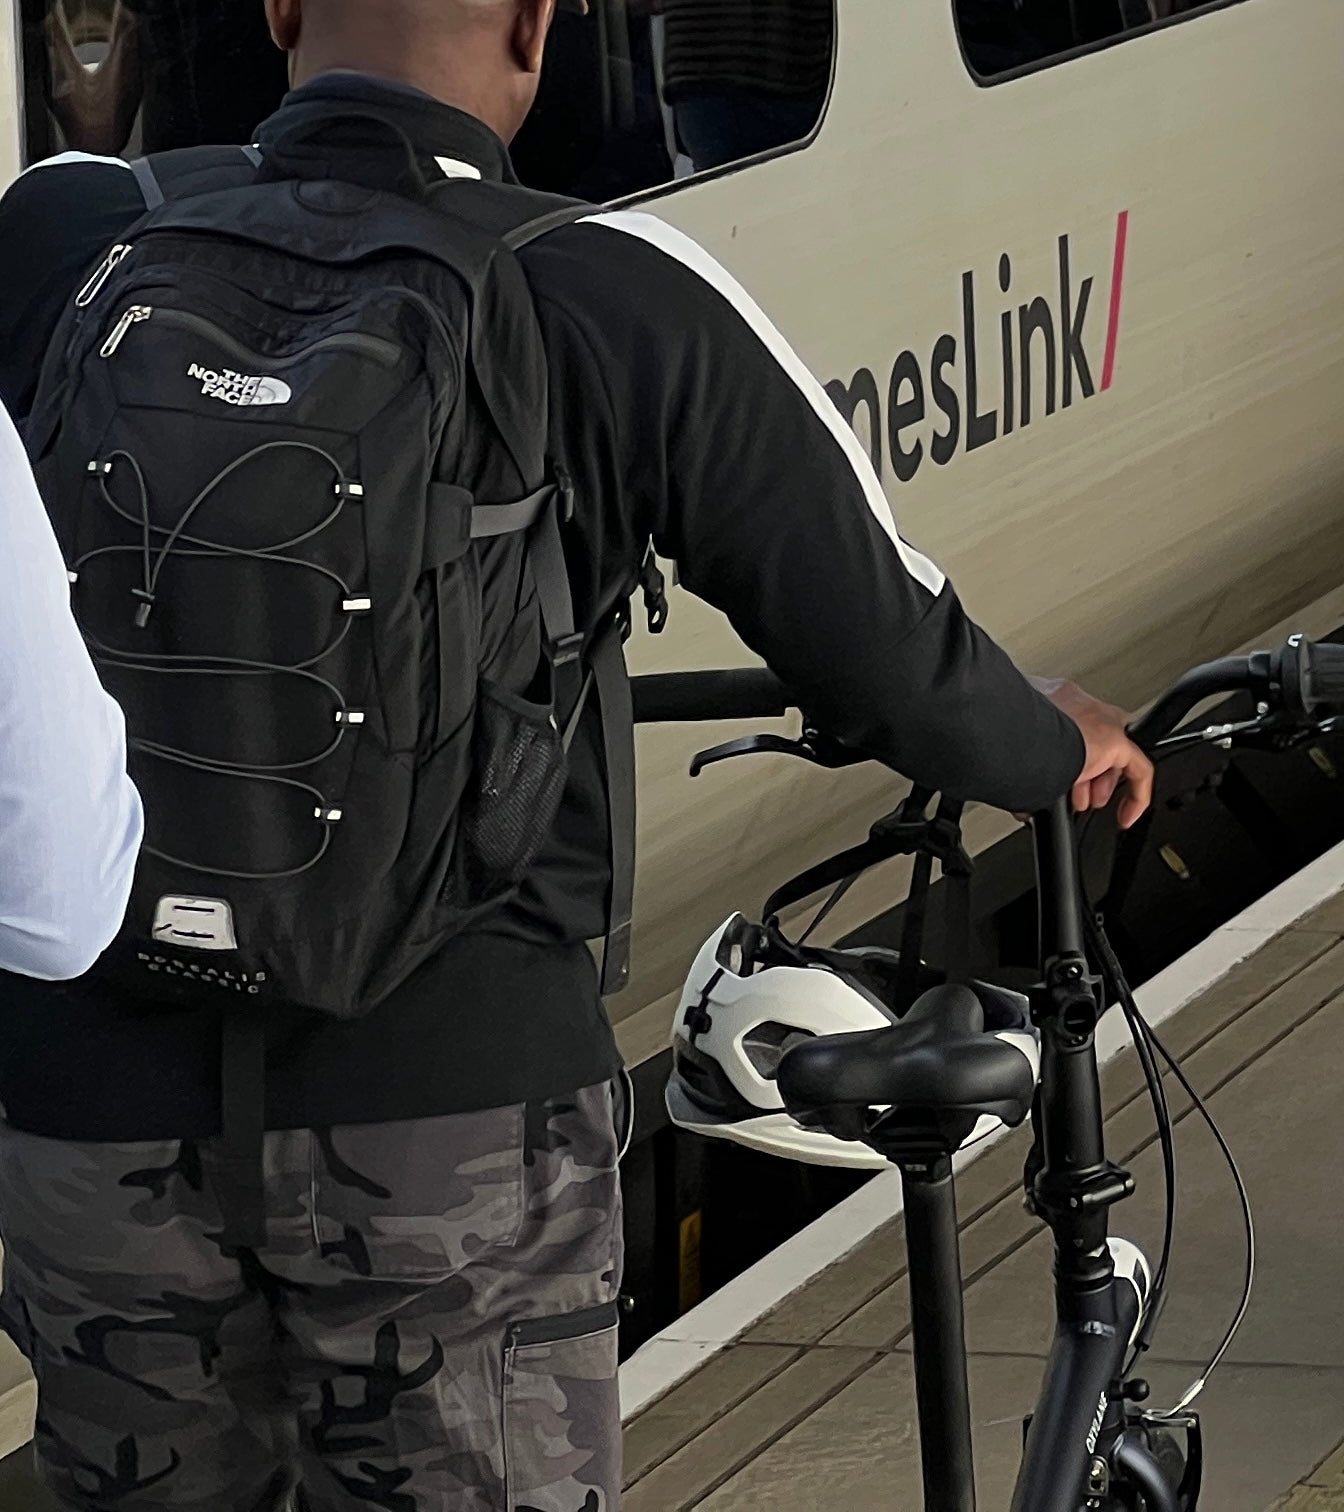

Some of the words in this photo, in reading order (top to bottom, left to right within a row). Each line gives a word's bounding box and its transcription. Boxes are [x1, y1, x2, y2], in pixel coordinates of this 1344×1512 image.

[187, 363, 257, 396] NORTH
[223, 368, 262, 385] THE
[201, 382, 252, 406] FACE
